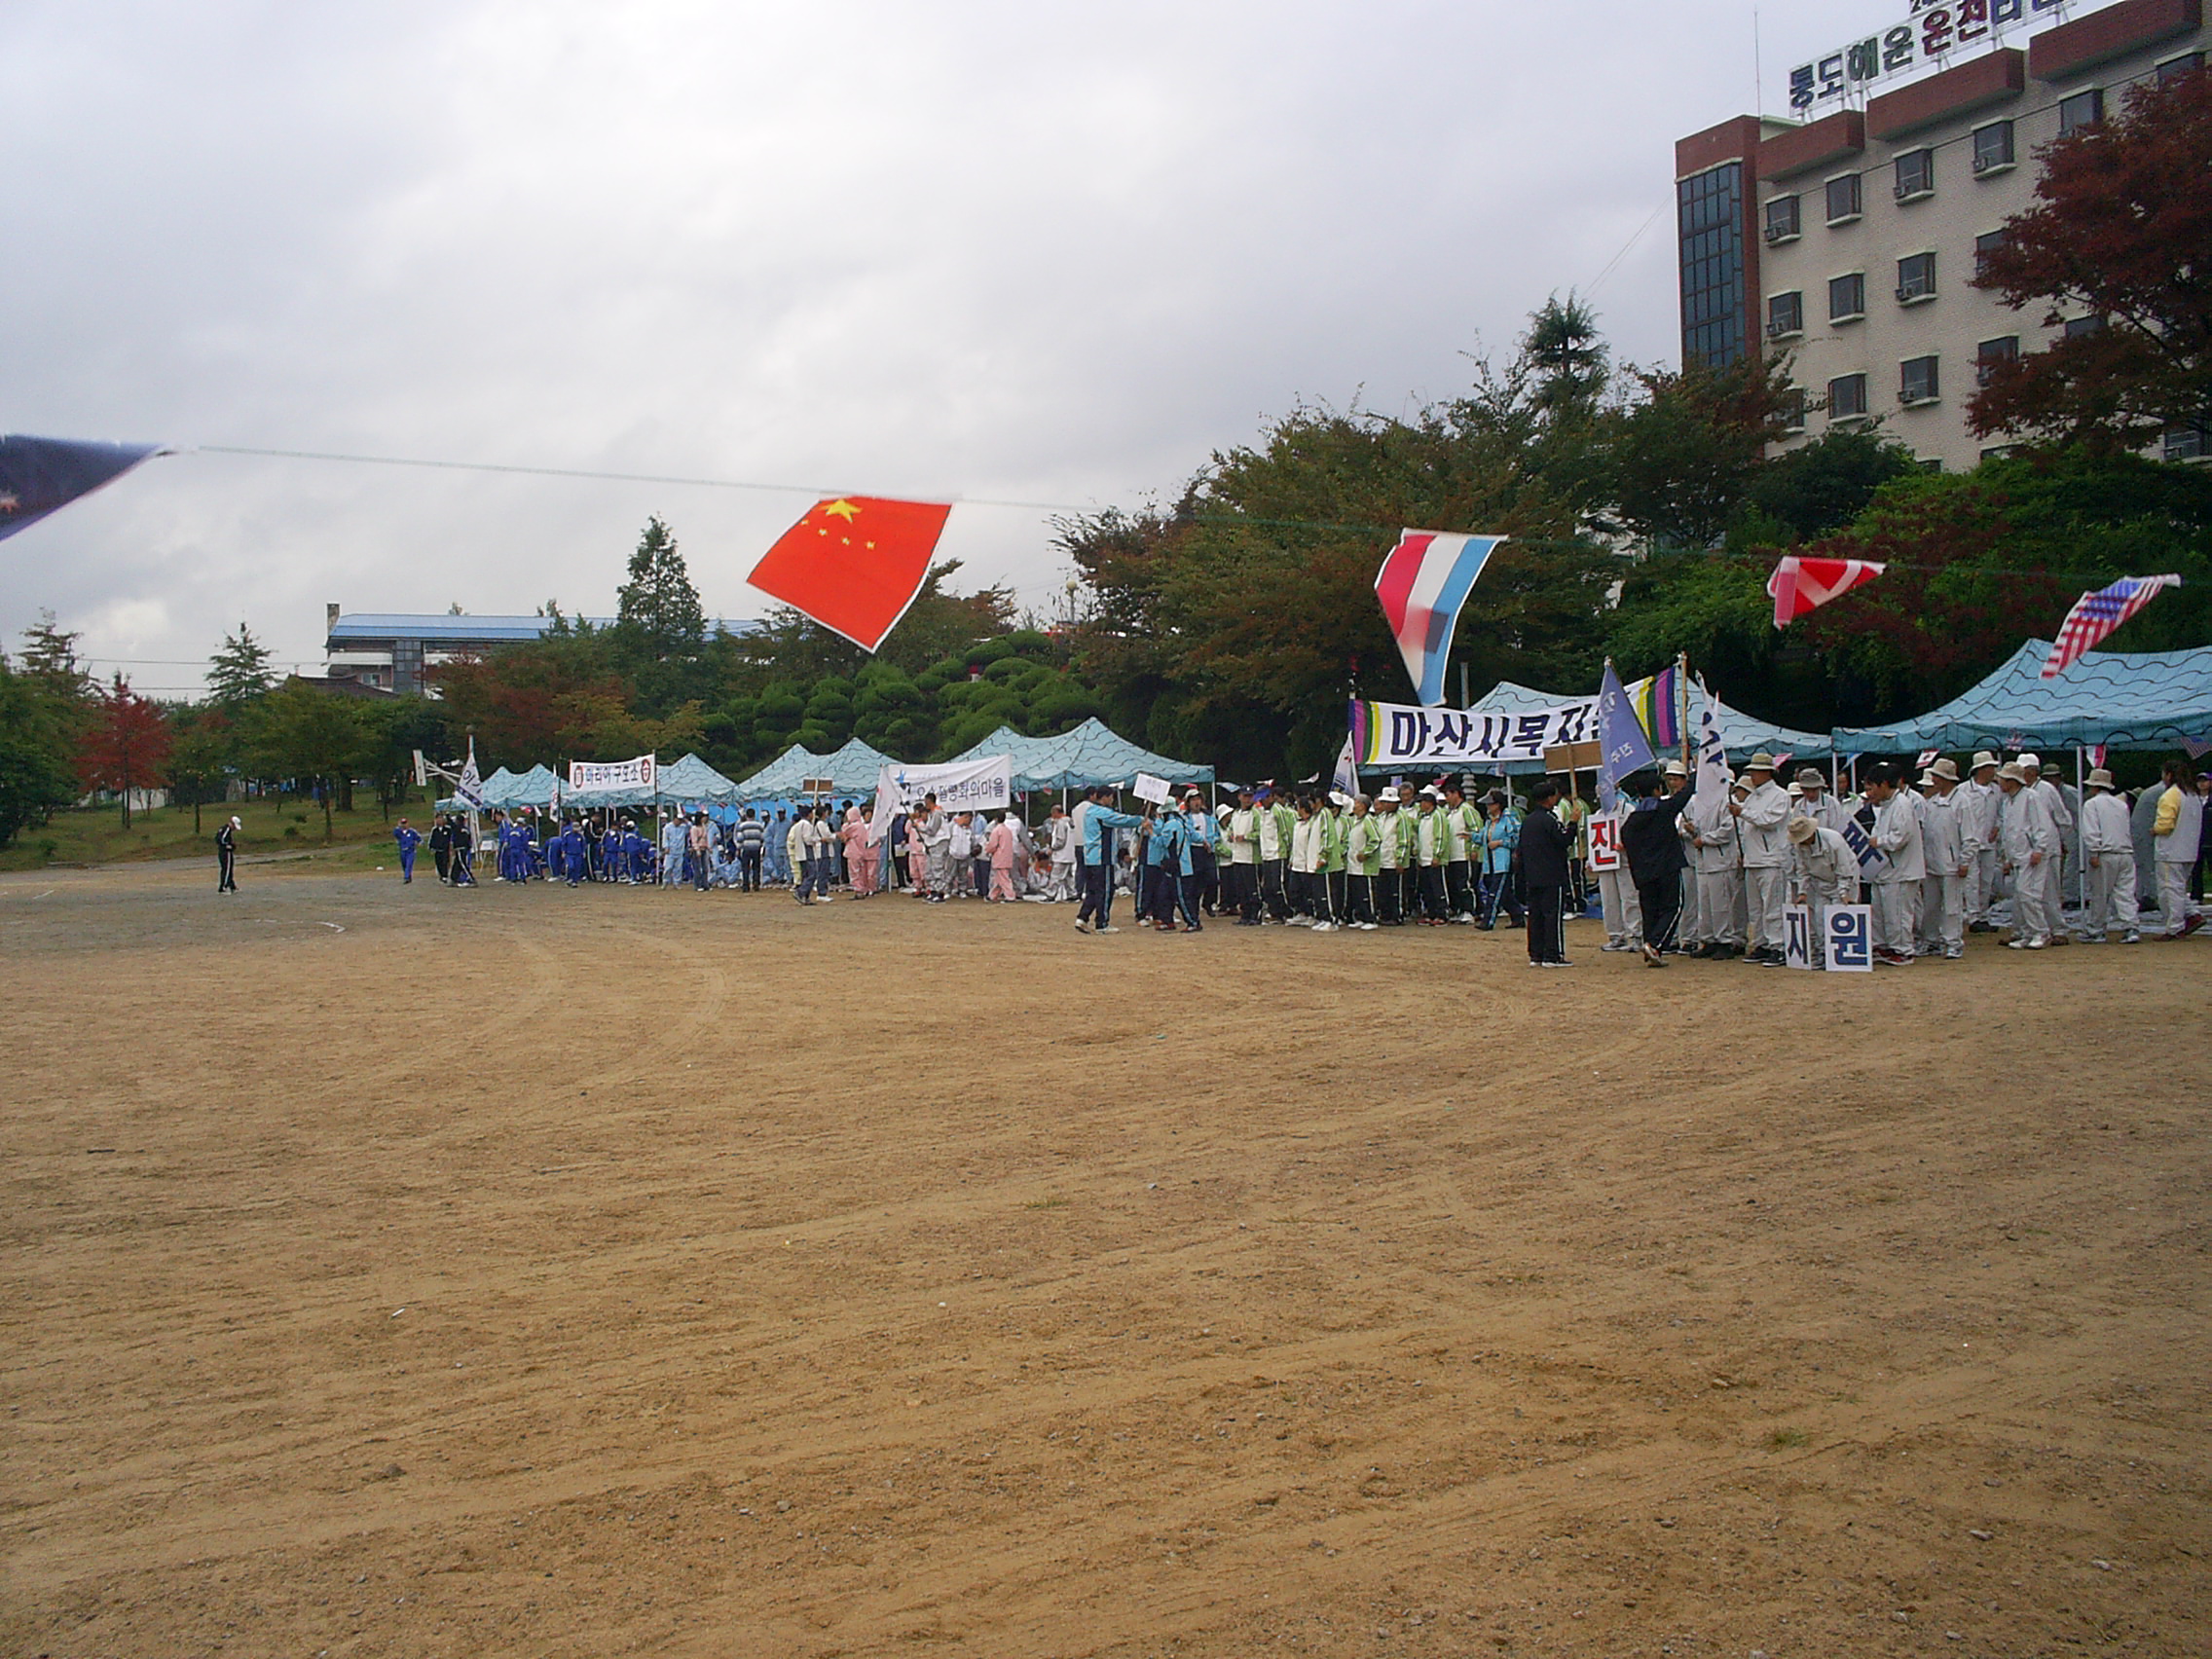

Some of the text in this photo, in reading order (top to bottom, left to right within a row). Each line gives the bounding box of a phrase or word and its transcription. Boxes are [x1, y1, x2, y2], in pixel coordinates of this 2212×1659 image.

[1591, 819, 1617, 866] 진
[1786, 912, 1809, 965] 지
[1830, 911, 1868, 966] 원
